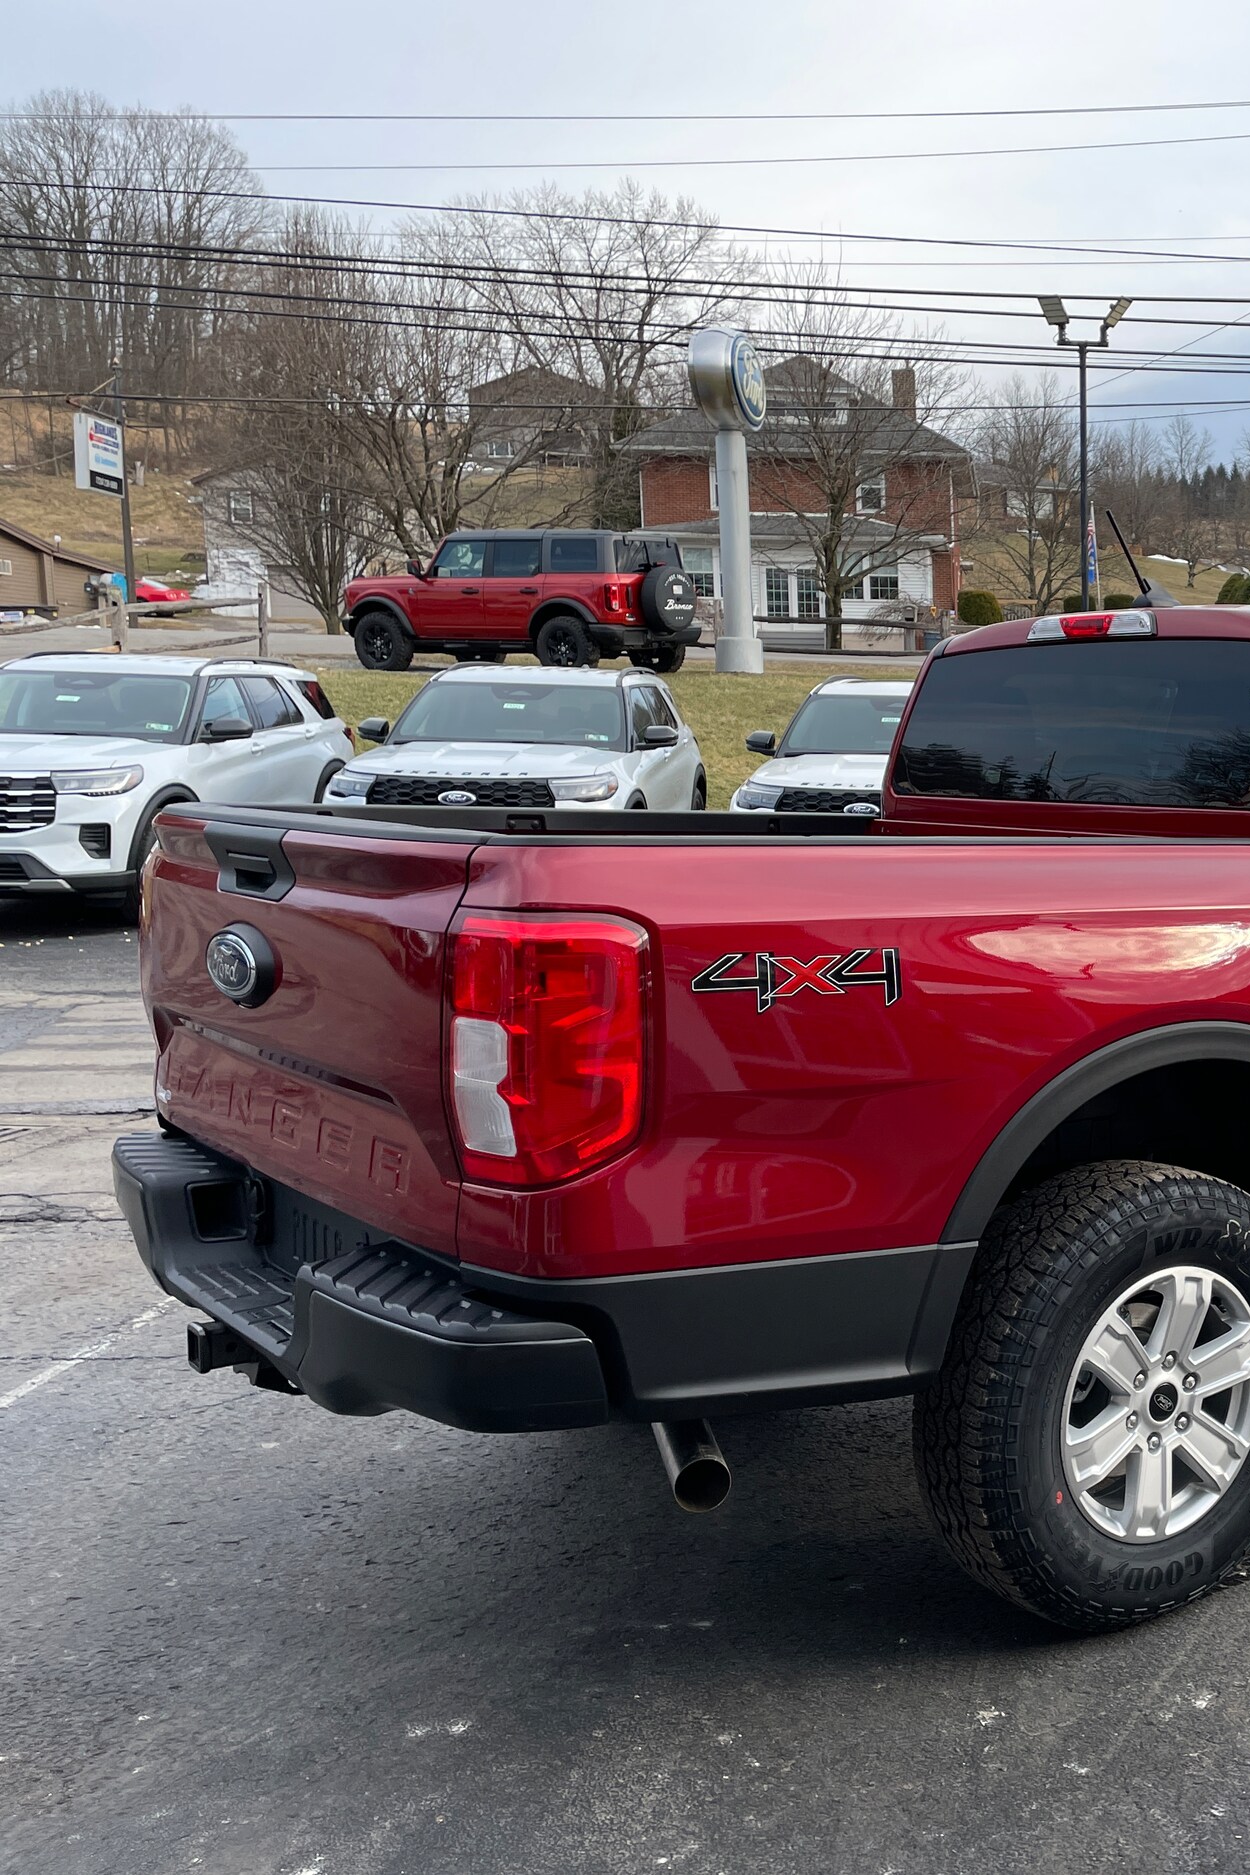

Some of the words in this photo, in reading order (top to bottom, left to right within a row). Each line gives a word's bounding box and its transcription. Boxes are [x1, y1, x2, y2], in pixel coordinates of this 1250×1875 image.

[664, 598, 694, 610] Bronco
[393, 769, 529, 777] EXPLORER
[165, 1050, 411, 1195] RANGER
